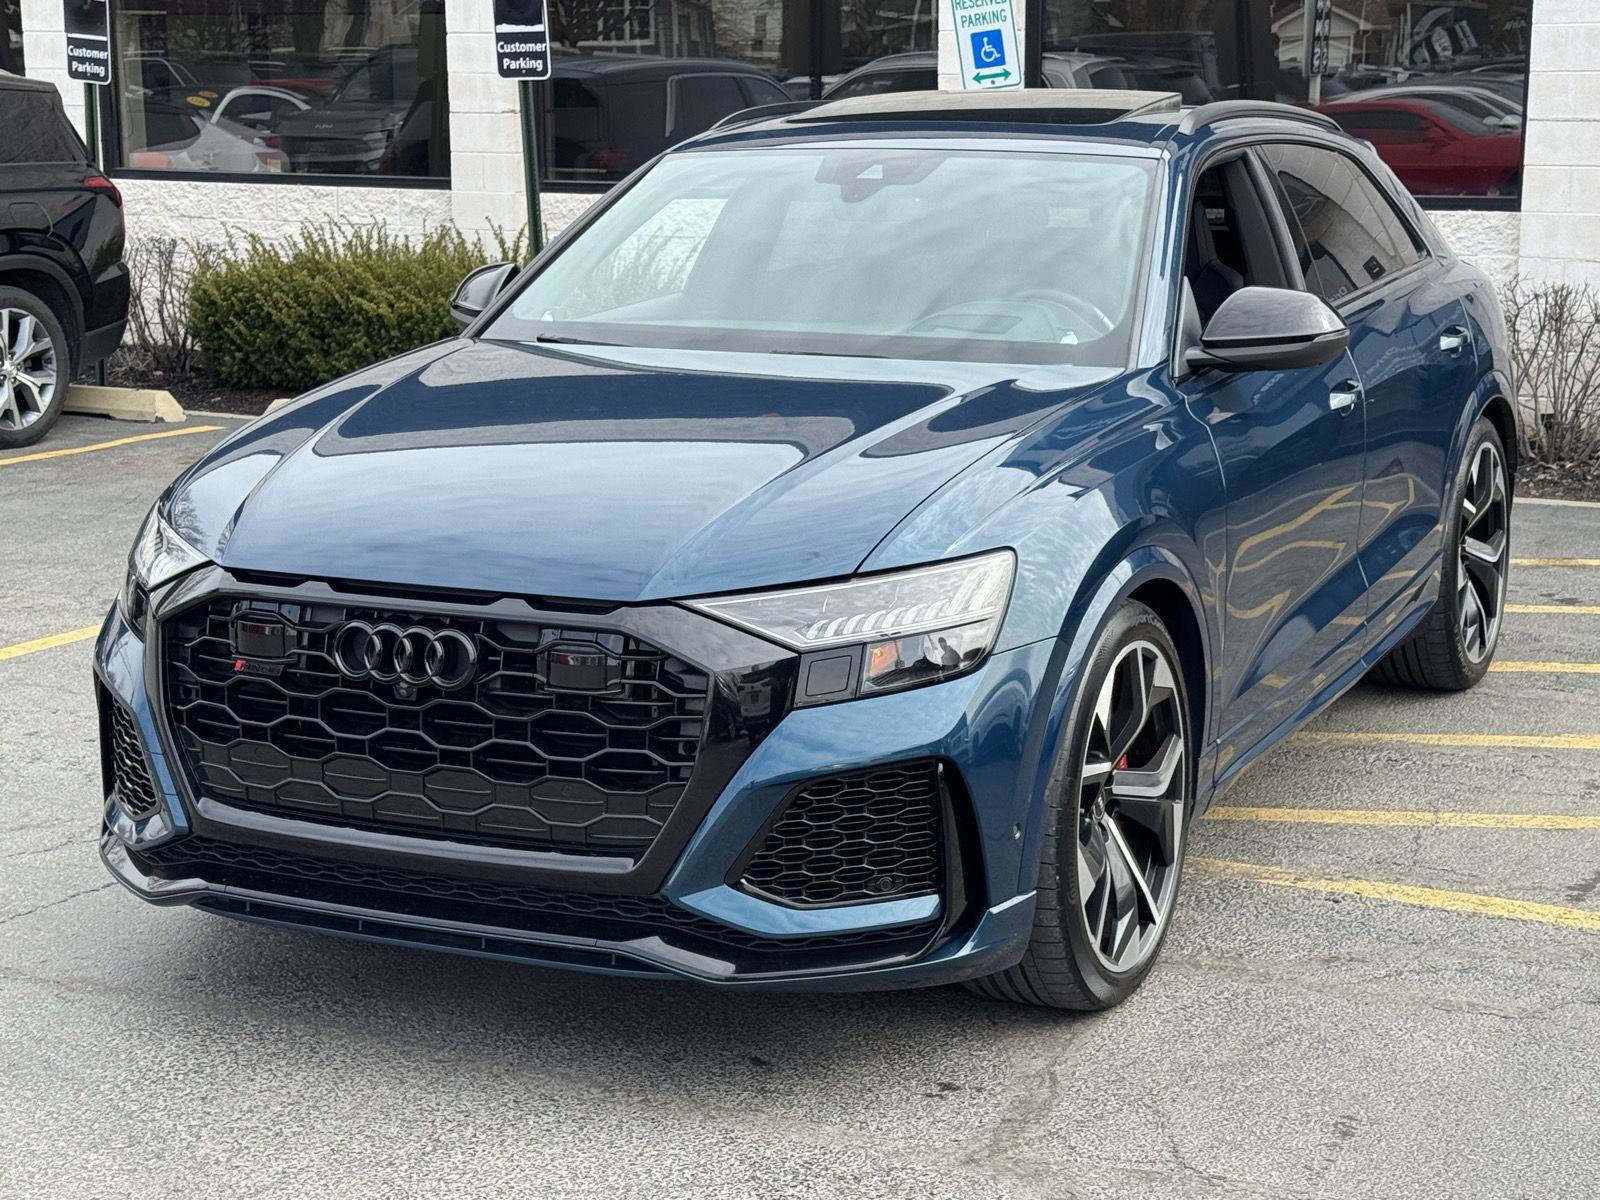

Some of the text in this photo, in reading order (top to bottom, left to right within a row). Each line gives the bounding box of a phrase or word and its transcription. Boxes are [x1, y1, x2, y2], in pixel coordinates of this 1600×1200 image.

[954, 0, 1007, 11] RESE
[960, 9, 1007, 28] PARKING
[68, 44, 108, 59] Customer
[497, 41, 546, 53] Customer
[72, 61, 105, 77] Parking
[503, 57, 543, 71] Parking
